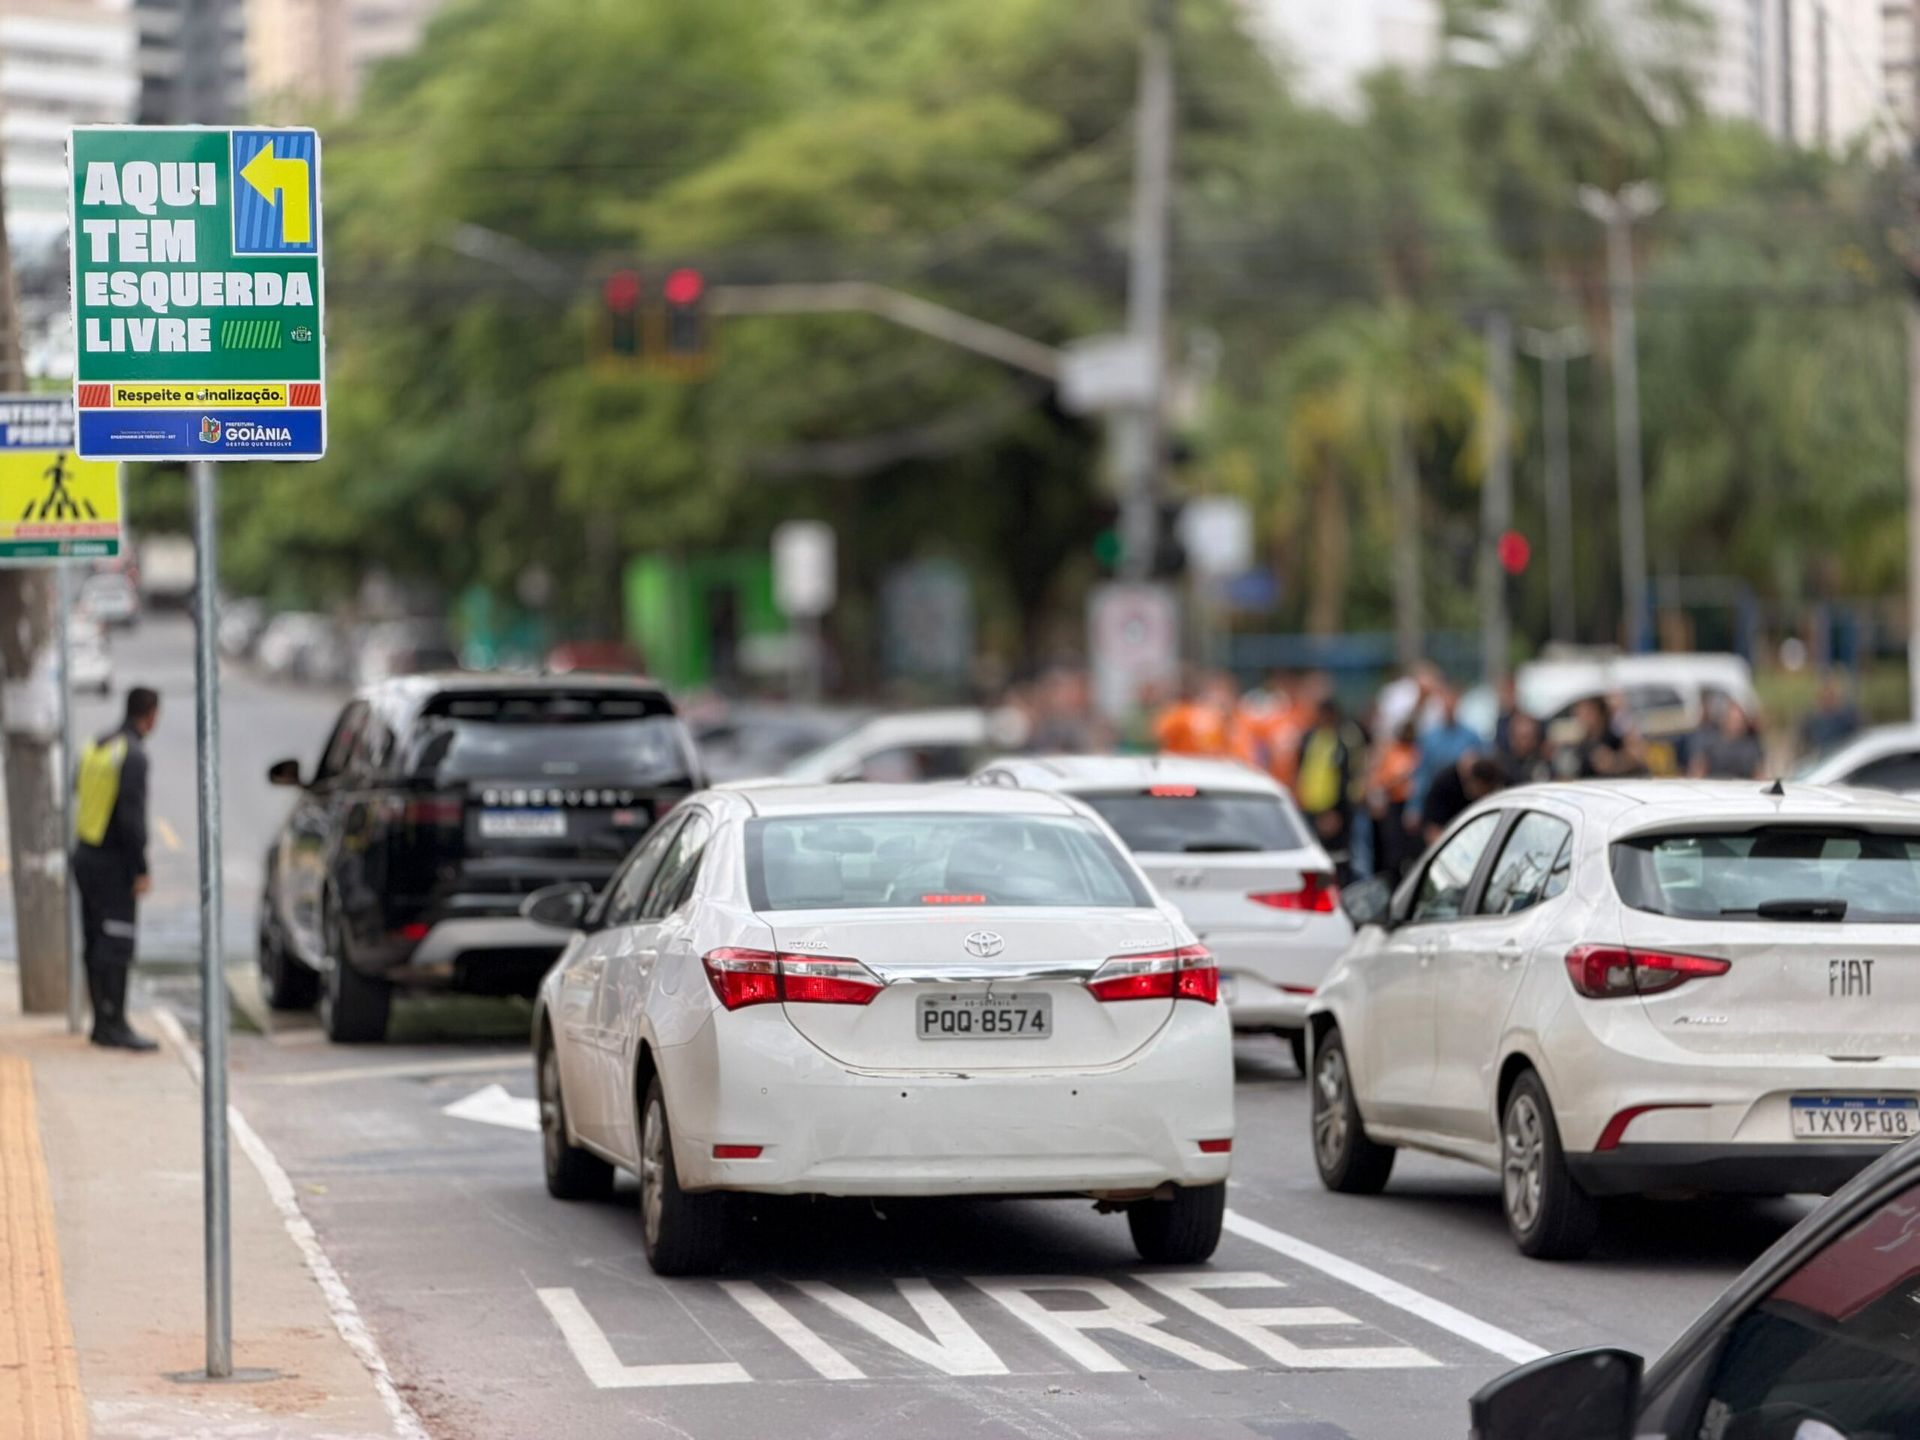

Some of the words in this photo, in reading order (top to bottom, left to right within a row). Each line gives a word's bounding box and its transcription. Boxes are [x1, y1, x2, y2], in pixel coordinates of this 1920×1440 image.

[83, 161, 217, 215] AQUI
[83, 219, 196, 263] TEM
[84, 271, 314, 314] ESQUERDA
[85, 317, 212, 352] LIVRE
[117, 389, 181, 404] Respeite
[184, 392, 194, 401] a
[197, 388, 283, 404] inalização.
[225, 425, 292, 441] GOIÂNIA
[1829, 959, 1875, 997] FIAT
[537, 1271, 1446, 1389] LIVRE
